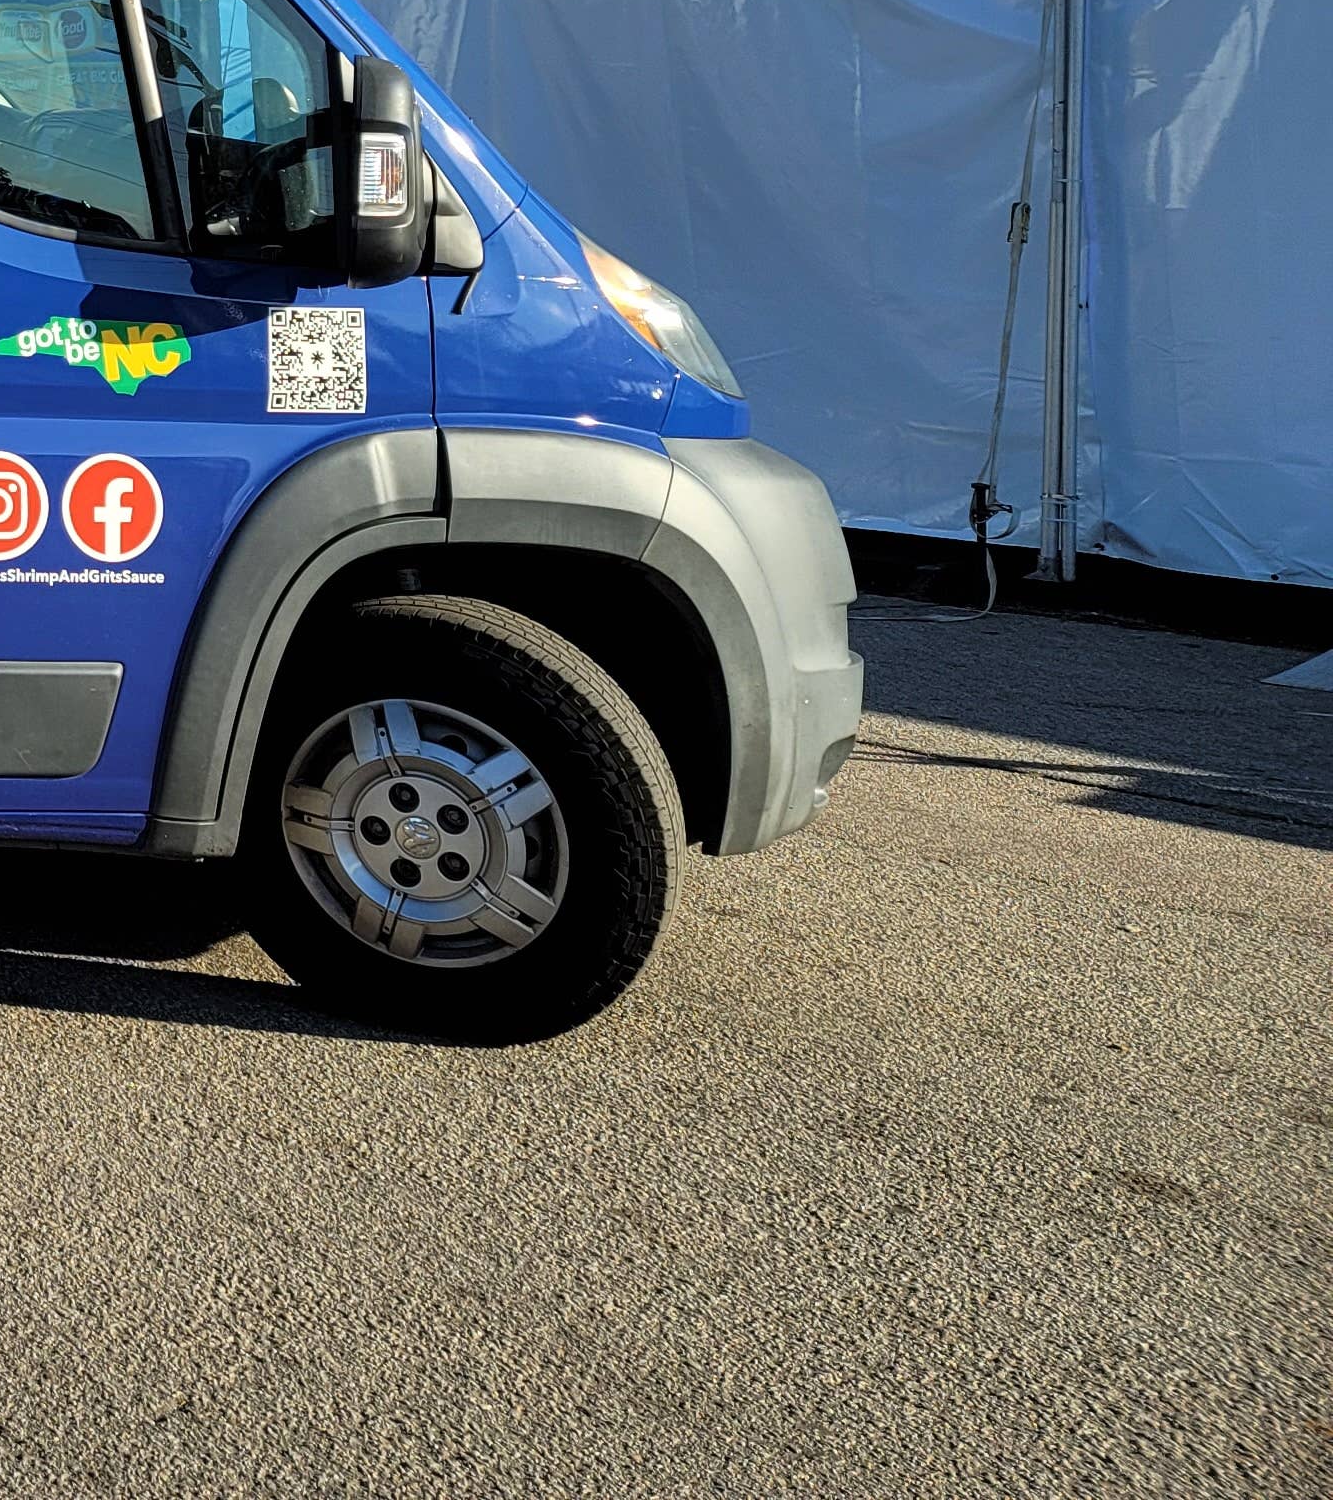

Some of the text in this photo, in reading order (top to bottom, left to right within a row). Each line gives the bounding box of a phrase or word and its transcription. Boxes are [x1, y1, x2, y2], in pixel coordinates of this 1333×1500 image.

[17, 318, 97, 357] got to
[65, 323, 180, 381] be NC
